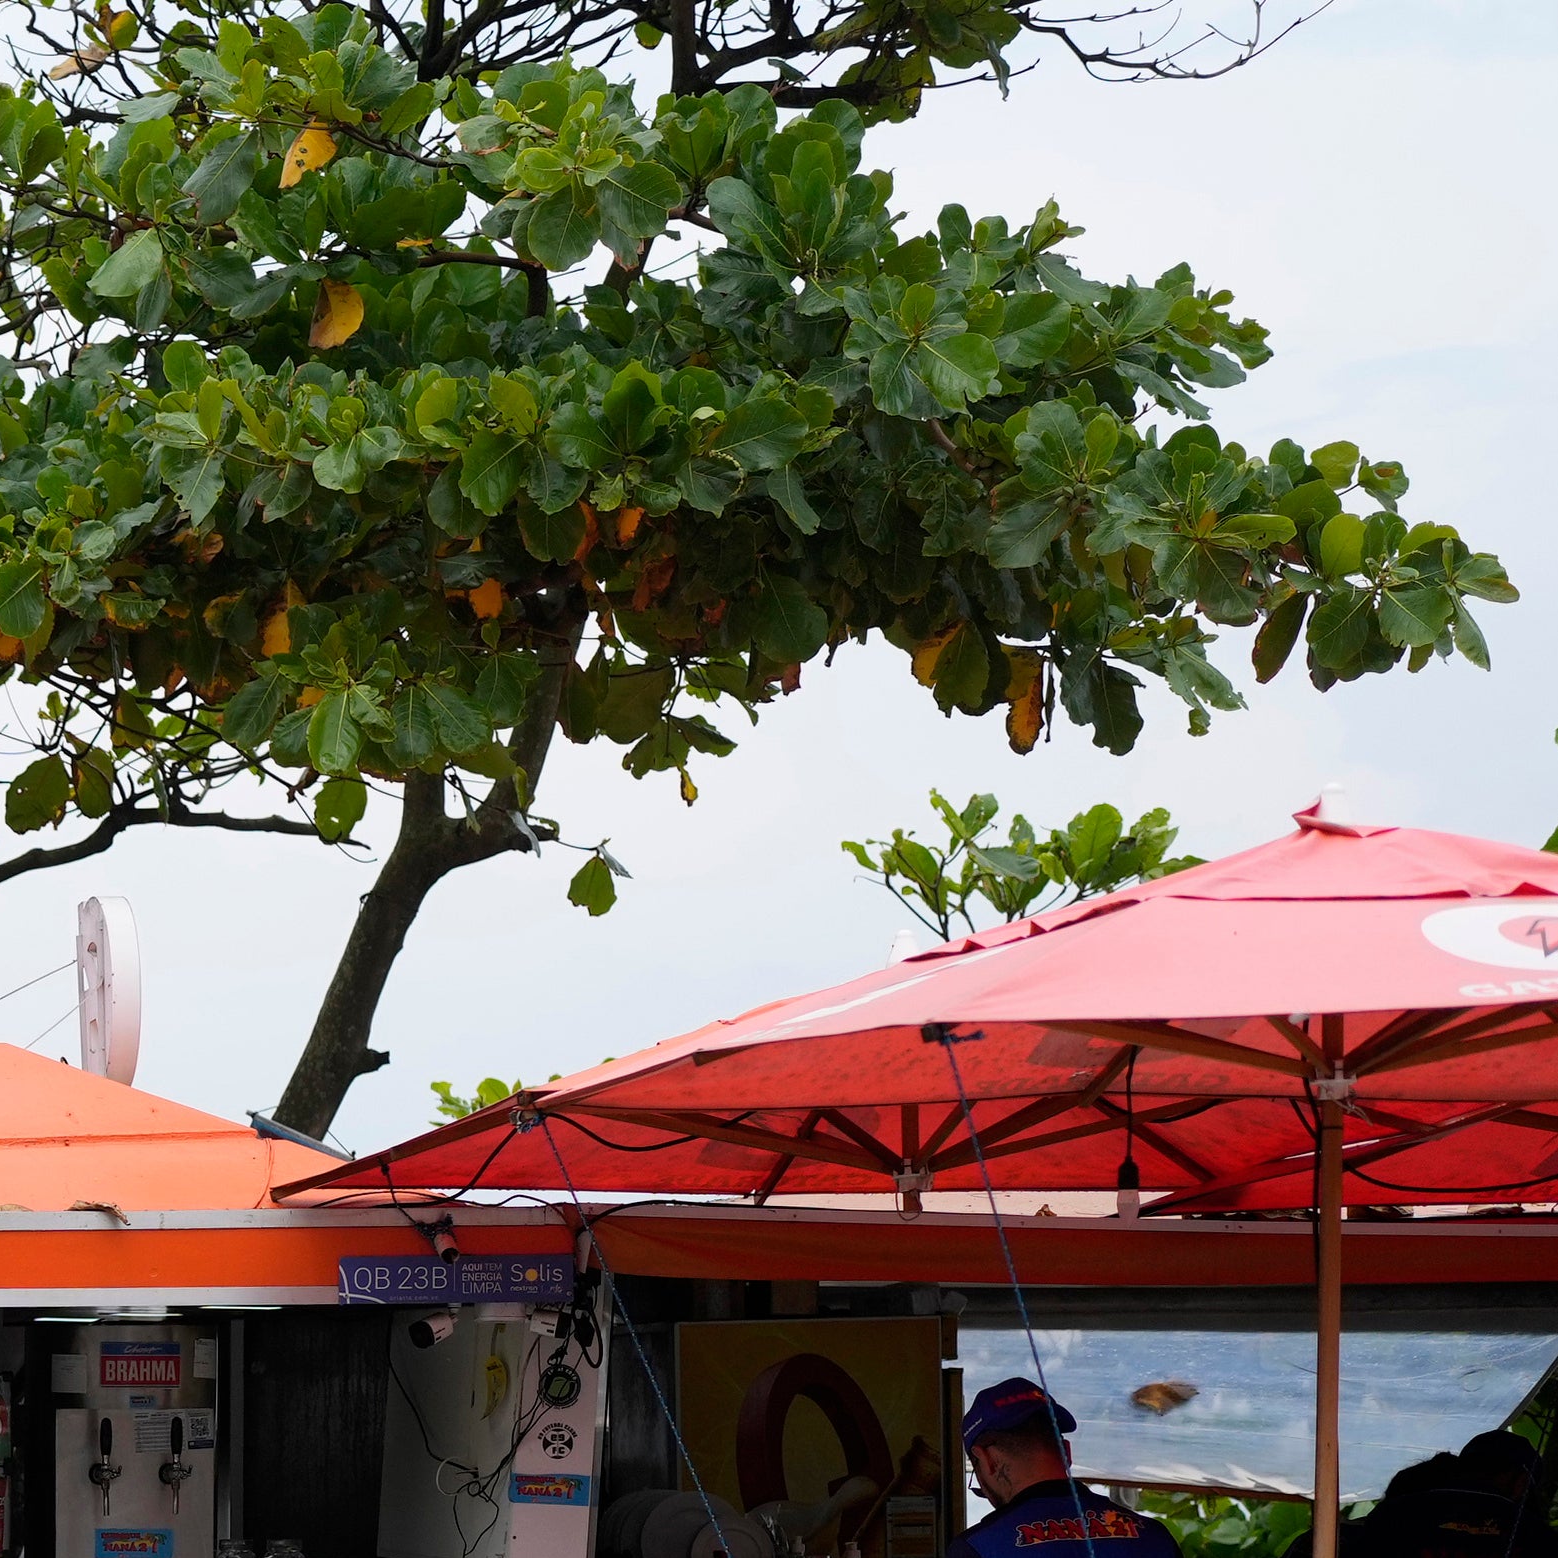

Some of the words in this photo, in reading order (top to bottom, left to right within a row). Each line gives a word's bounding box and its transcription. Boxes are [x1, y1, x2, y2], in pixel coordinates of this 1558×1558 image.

[462, 1263, 484, 1272] AQUI
[485, 1263, 503, 1272] TEM
[354, 1267, 391, 1293] QB
[397, 1266, 448, 1291] 23B
[462, 1272, 503, 1282] ENERGIA
[462, 1282, 503, 1294] LIMPA
[106, 1359, 177, 1382] BRAHMA
